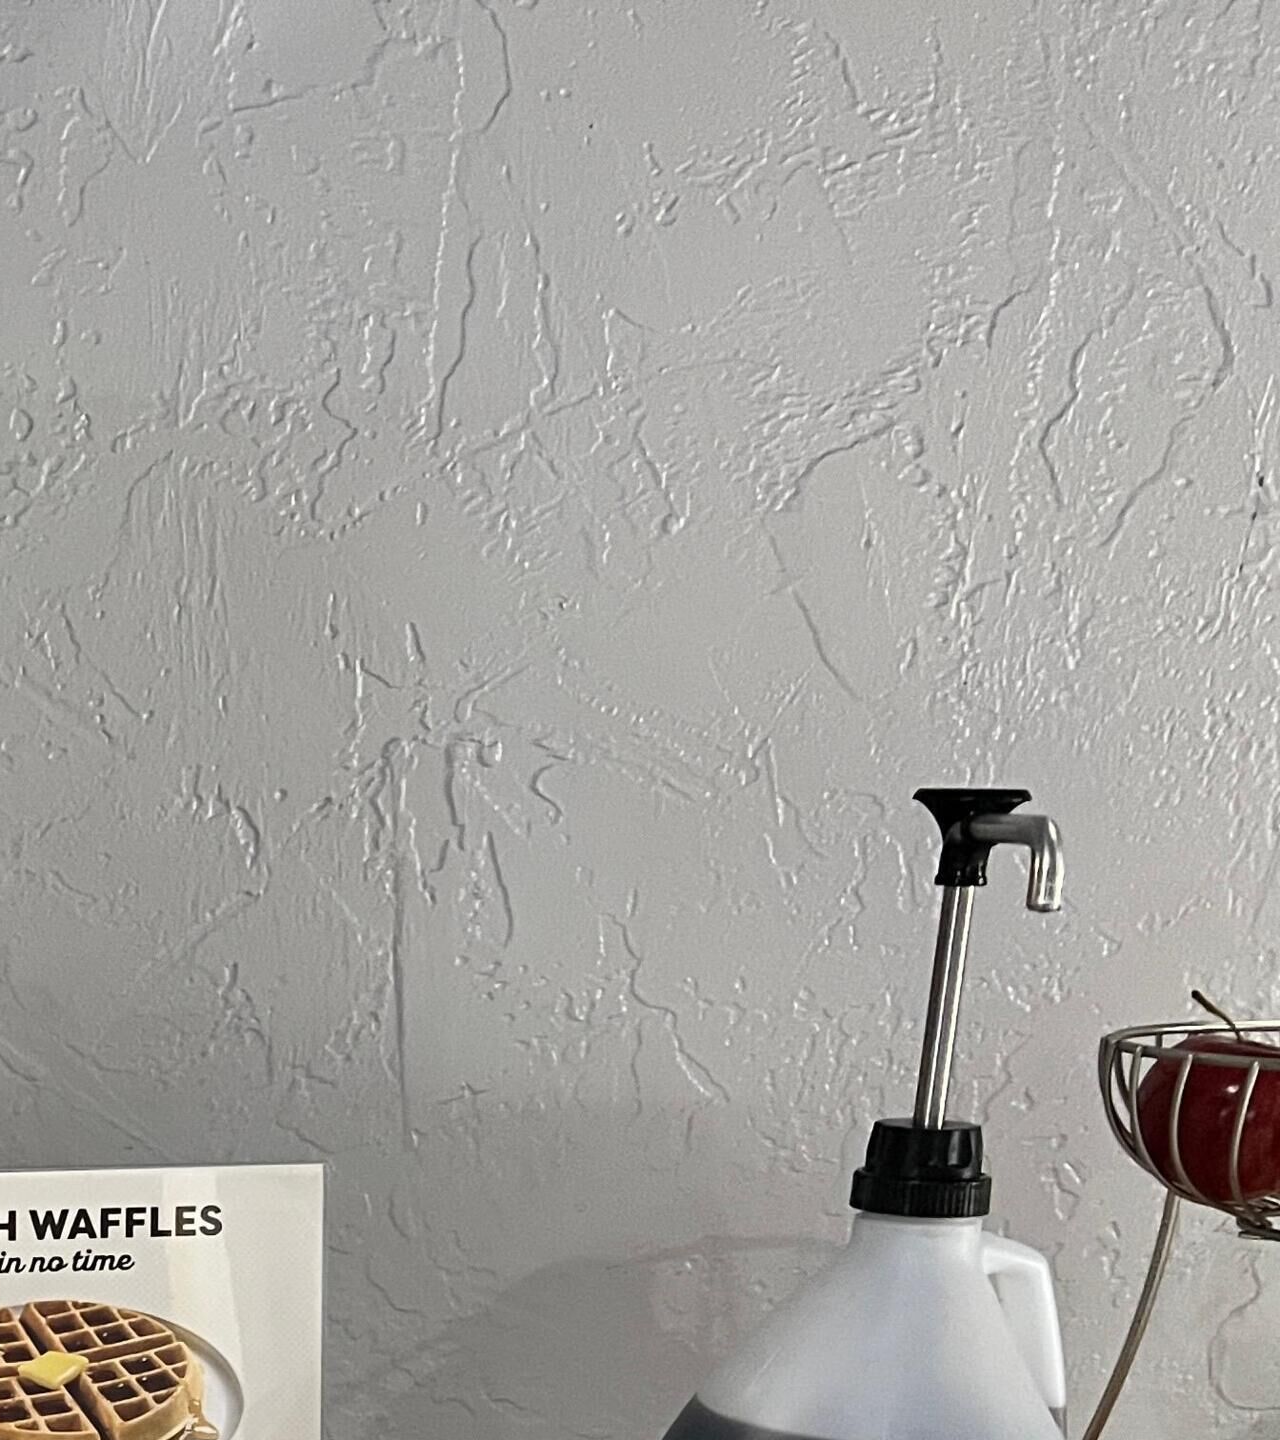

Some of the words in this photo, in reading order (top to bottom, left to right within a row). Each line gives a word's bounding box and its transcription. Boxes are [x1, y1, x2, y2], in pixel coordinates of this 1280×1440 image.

[28, 1205, 224, 1241] WAFFLES
[28, 1252, 69, 1273] no
[71, 1248, 136, 1272] time
